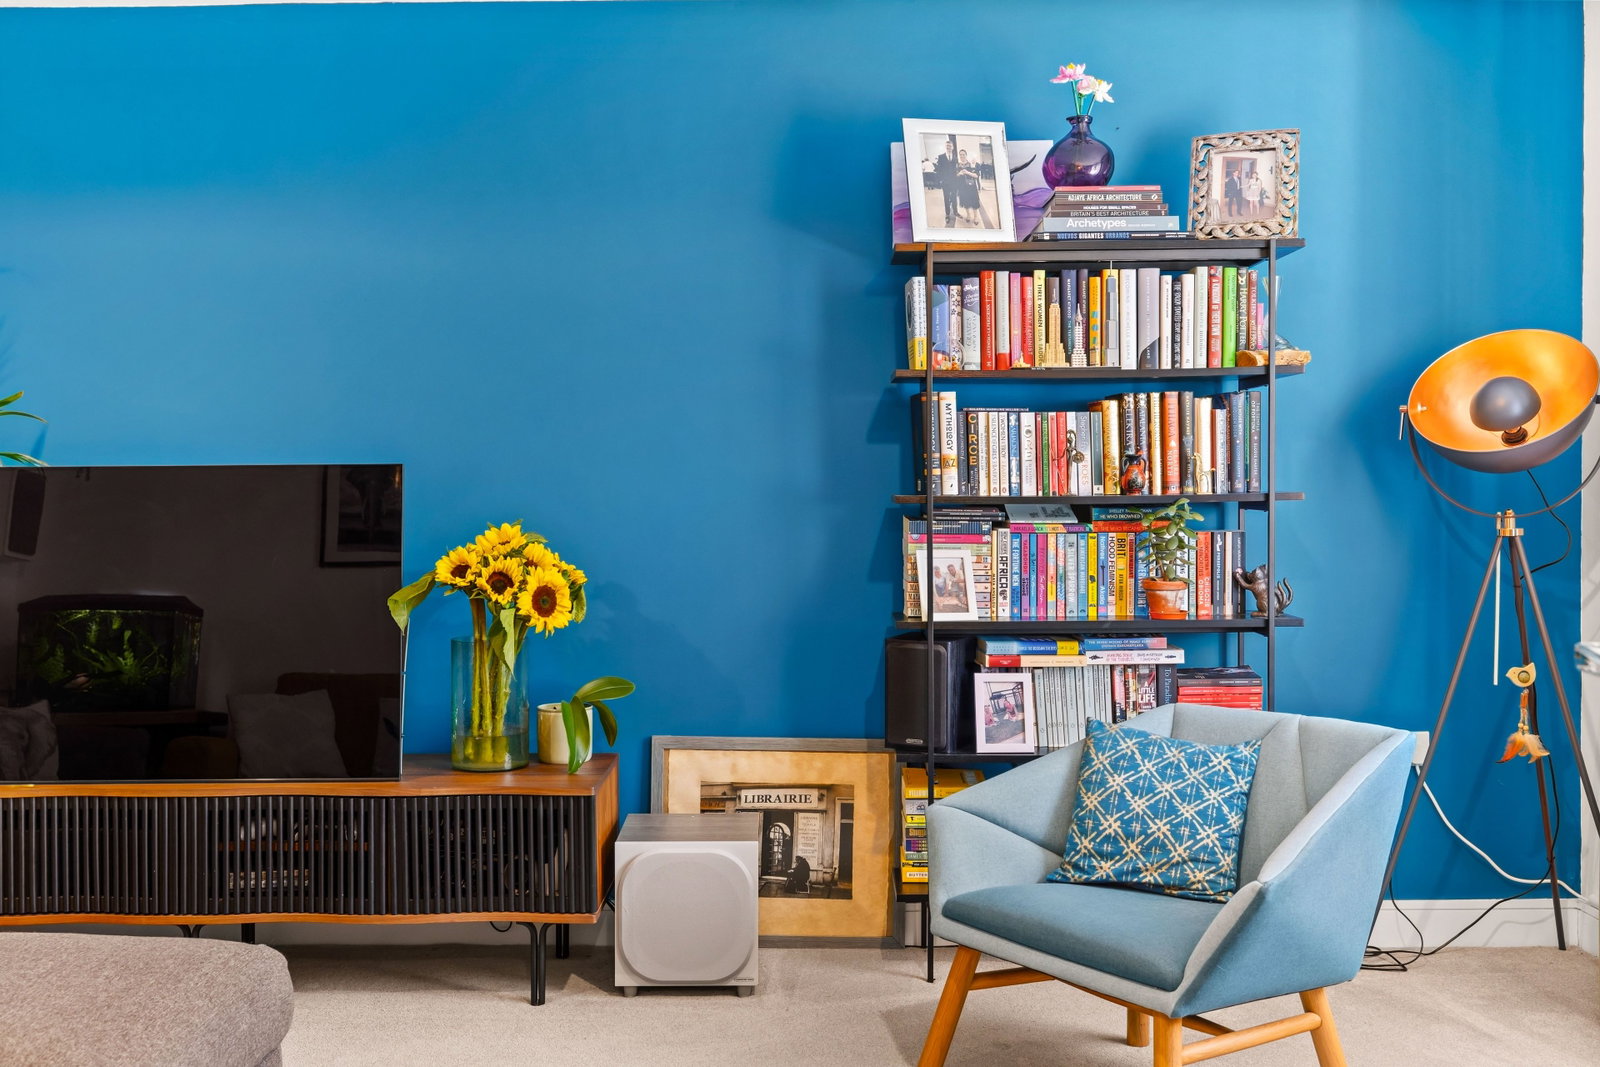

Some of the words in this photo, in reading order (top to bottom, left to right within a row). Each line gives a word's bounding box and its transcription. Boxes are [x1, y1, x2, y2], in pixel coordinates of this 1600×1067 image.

[1066, 218, 1126, 230] Archetypes
[1239, 287, 1247, 314] HARRY
[1239, 316, 1247, 345] POTTER
[945, 403, 953, 451] MYTHOLOGY
[968, 414, 977, 465] CIRCE
[1080, 415, 1088, 440] Stephen
[999, 555, 1008, 588] AFRICA
[1138, 593, 1146, 607] DIRT
[1165, 668, 1171, 677] To
[1139, 694, 1155, 703] LIFE
[743, 794, 812, 804] LIBRAIRIE
